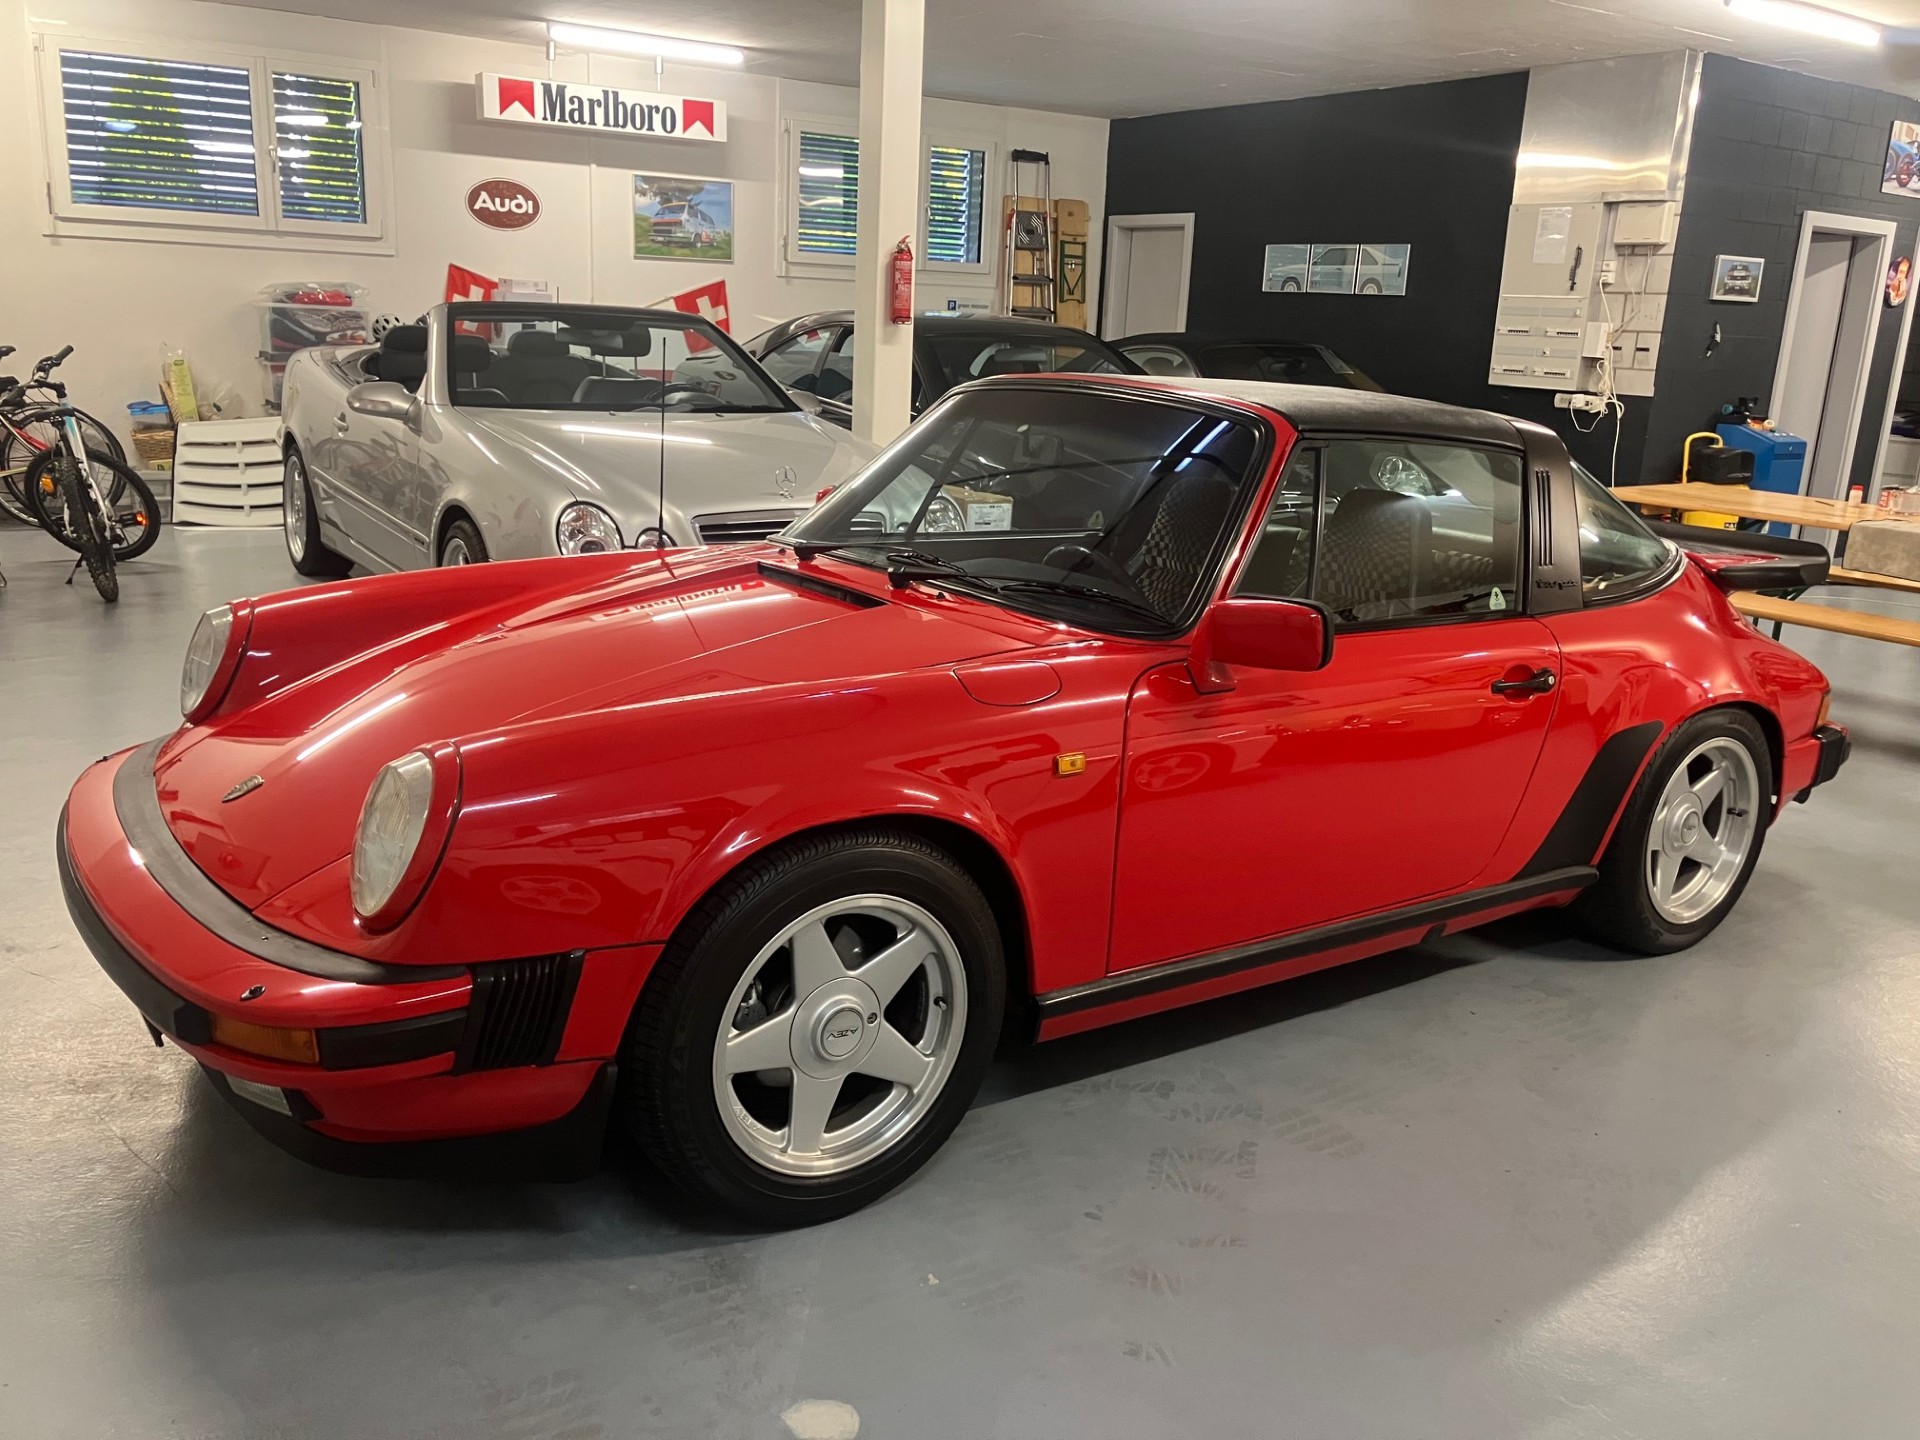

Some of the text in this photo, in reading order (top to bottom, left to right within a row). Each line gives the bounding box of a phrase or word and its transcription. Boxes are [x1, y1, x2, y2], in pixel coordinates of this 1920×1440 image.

[540, 82, 677, 134] Marlboro
[473, 190, 533, 214] Audi
[826, 1027, 859, 1040] AZEV
